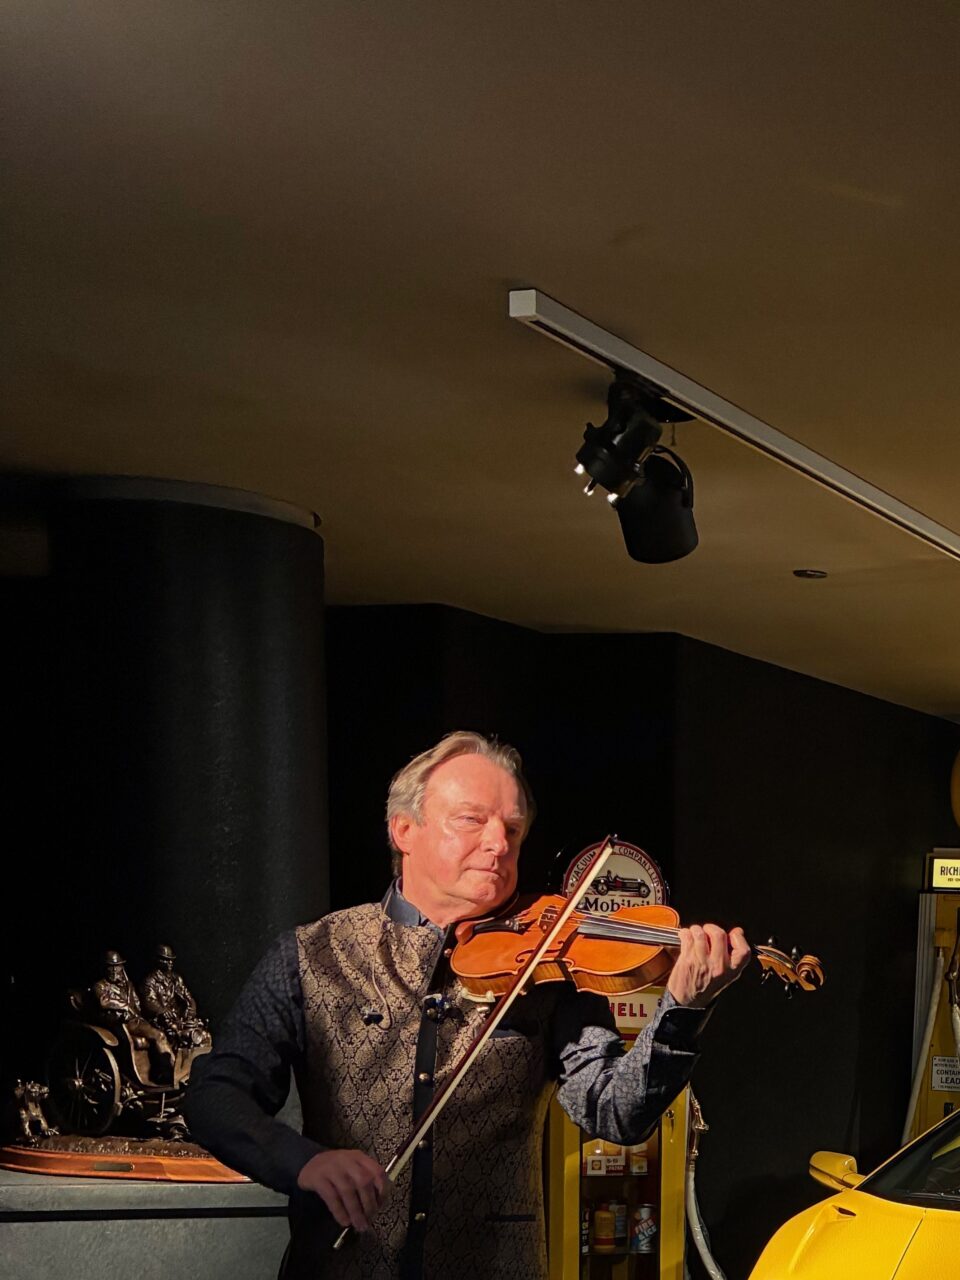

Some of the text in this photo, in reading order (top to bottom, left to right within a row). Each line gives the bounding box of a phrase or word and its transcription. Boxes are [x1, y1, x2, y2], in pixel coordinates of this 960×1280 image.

[571, 851, 596, 881] VACUUM
[619, 847, 652, 871] COMPANY
[608, 1003, 648, 1018] HELL
[940, 1077, 960, 1085] LEAD
